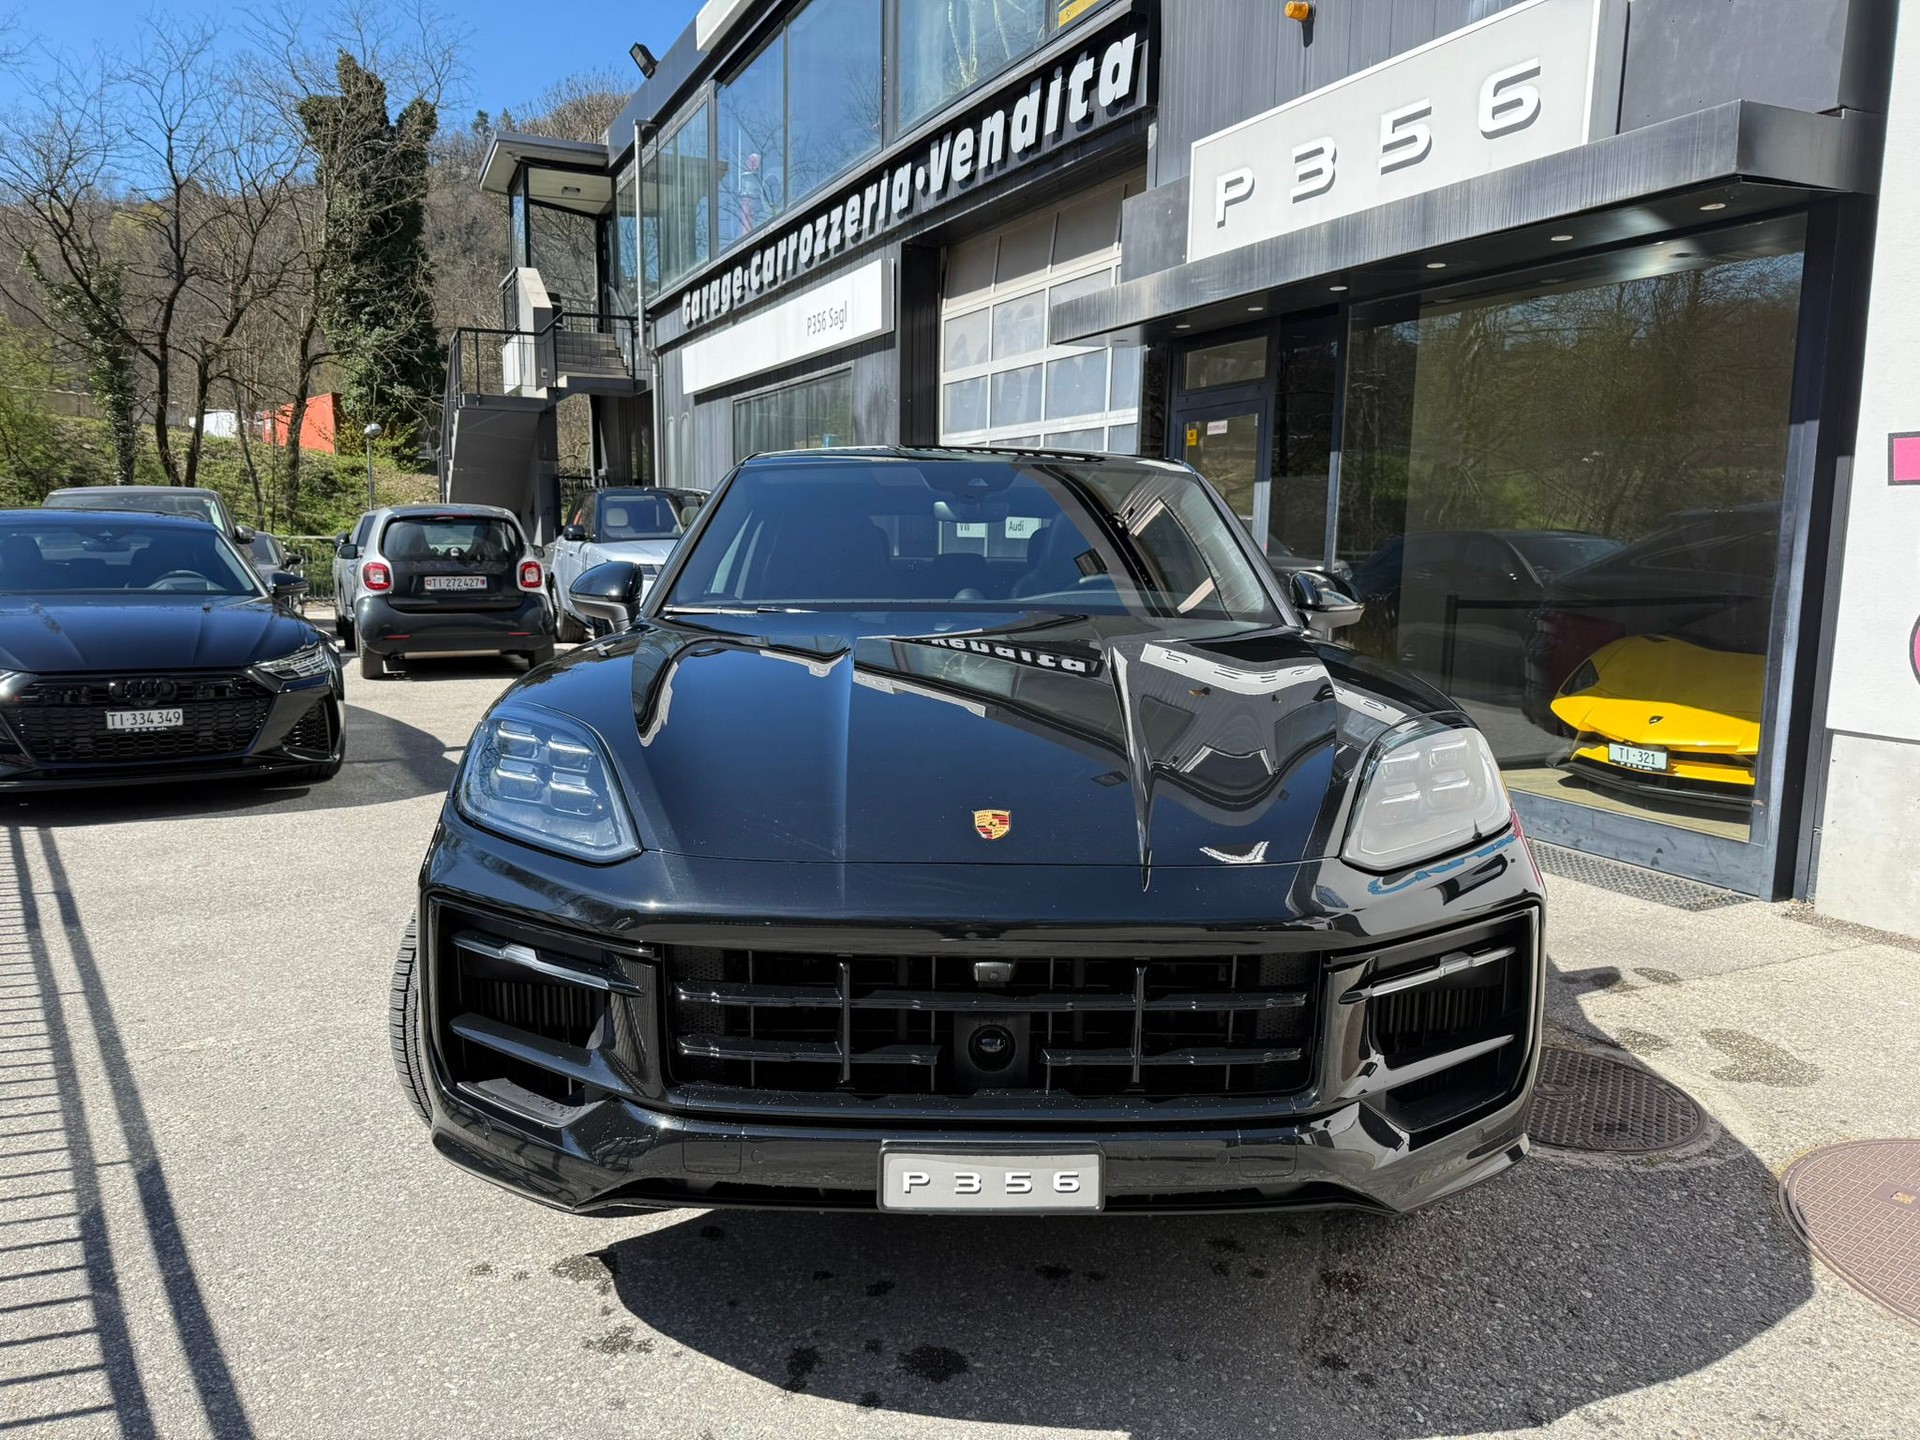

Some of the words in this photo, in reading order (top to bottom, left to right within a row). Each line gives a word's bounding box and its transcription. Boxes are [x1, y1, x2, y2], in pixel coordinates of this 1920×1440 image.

[807, 311, 827, 336] P356
[829, 300, 847, 330] Sagl
[1008, 520, 1025, 532] Audi
